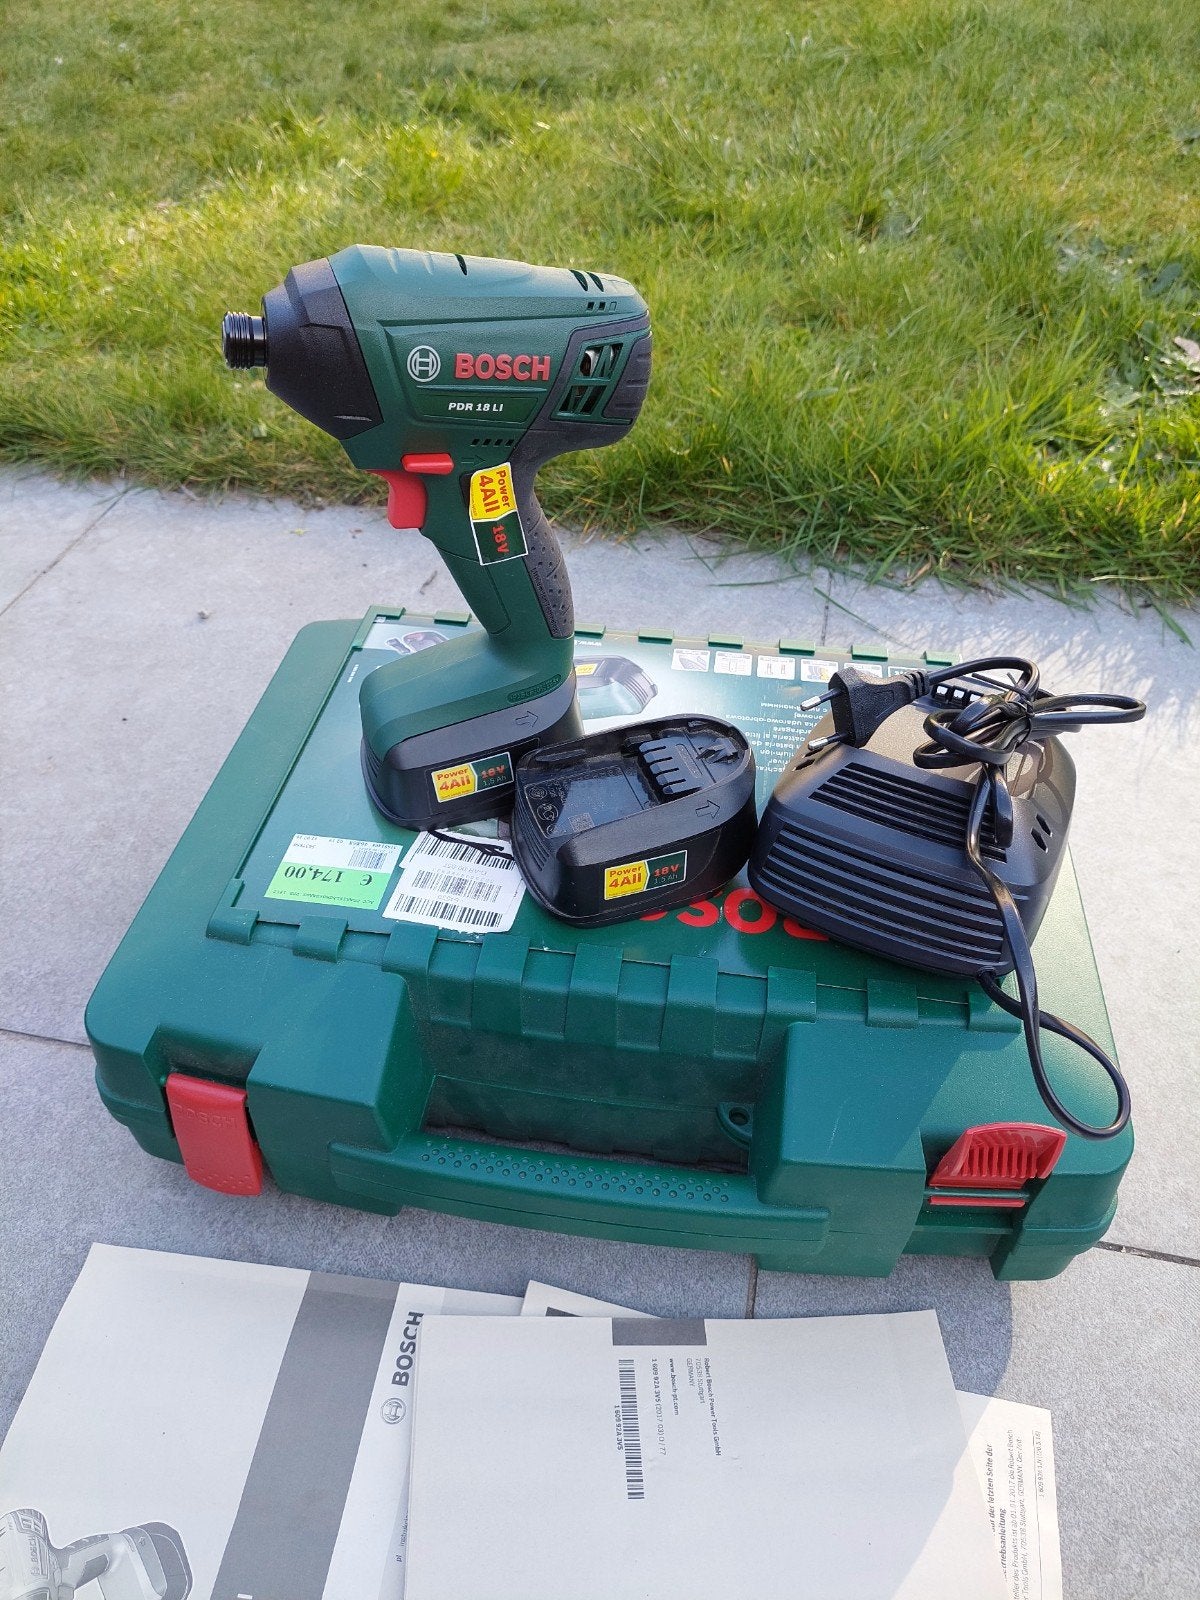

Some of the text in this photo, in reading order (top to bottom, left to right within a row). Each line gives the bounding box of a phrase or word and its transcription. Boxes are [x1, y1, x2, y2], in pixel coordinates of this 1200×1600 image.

[455, 352, 551, 381] BOSCH
[448, 402, 503, 412] PDR 18 LI
[478, 474, 501, 513] 4All
[496, 469, 510, 508] Power
[492, 525, 510, 554] 18V
[437, 768, 469, 781] Power
[440, 775, 471, 791] 4All
[284, 865, 373, 886] € 174,00
[608, 873, 642, 888] 4All
[609, 866, 642, 877] Power
[653, 863, 680, 877] 18V
[391, 1311, 424, 1387] BOSCH
[686, 1358, 695, 1387] GERMANY
[669, 1358, 679, 1415] www.bosch-pt.com
[706, 1379, 715, 1397] Bosch
[713, 1436, 721, 1455] GmbH
[985, 1444, 993, 1457] der
[987, 1478, 995, 1504] letzten
